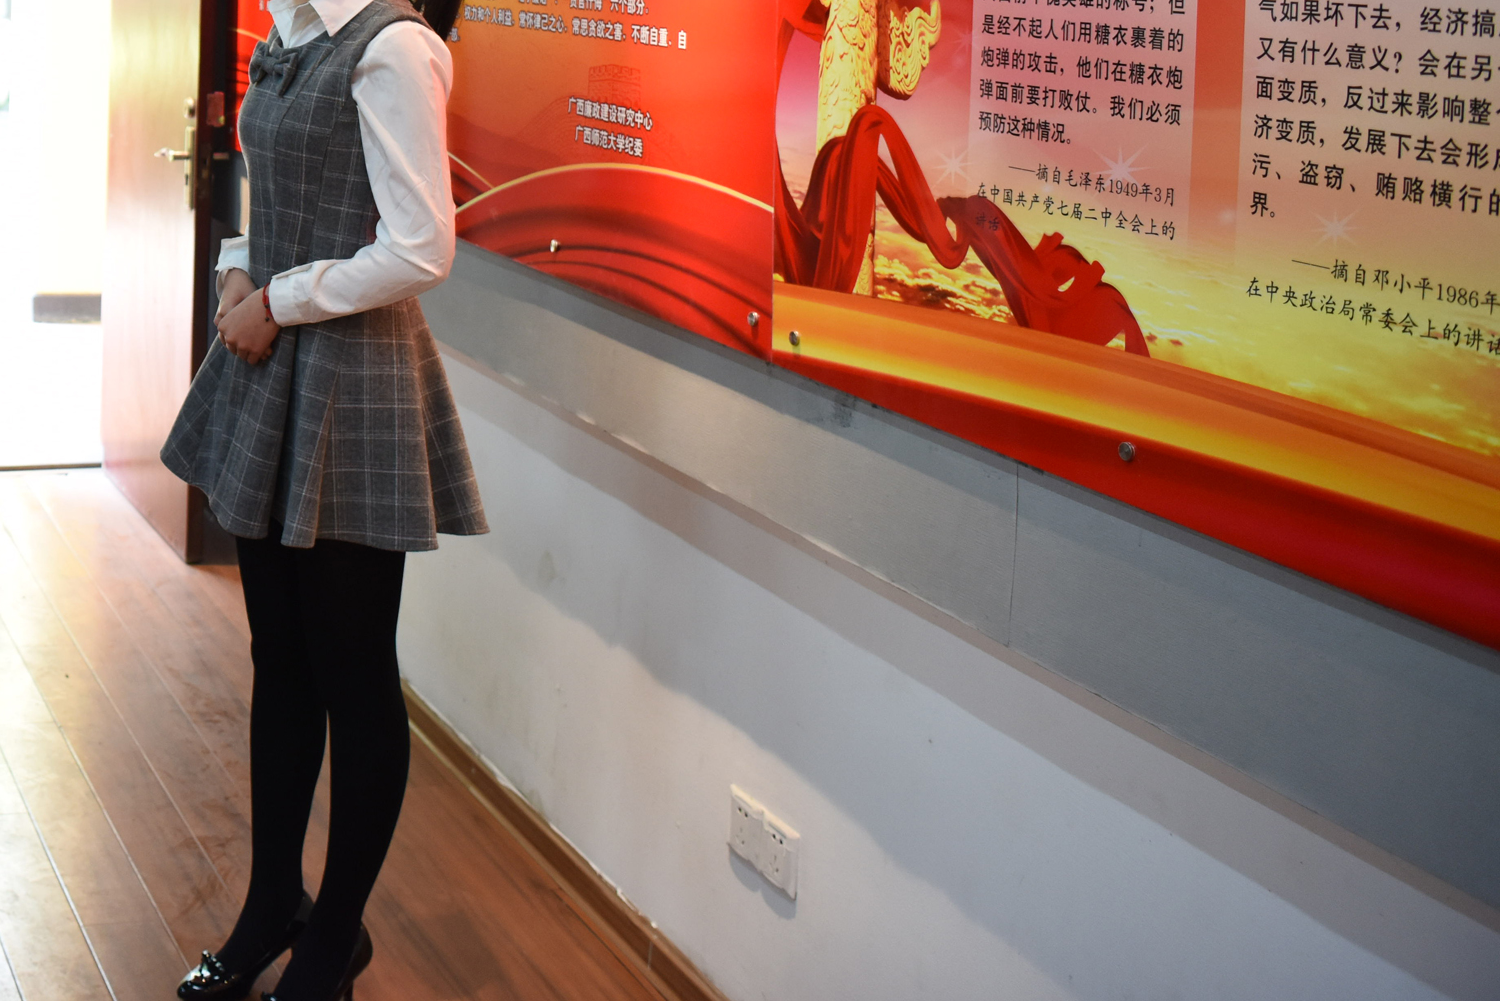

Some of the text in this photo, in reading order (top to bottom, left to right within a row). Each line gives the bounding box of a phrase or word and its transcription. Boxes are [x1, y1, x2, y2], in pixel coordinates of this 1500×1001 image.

[981, 14, 1184, 52] 是经不起人们用糖衣裹着的
[980, 47, 1183, 90] 炮弹的攻击，他们在糖衣炮
[1256, 36, 1500, 82] 又有什么意义？会在另
[567, 96, 654, 131] 广西廉政建设研究中心
[979, 79, 1182, 126] 弹面前要打败仗。我们必须
[1255, 75, 1500, 126] 面变质，反过来影响整
[575, 124, 644, 158] 广西师范大学纪委
[978, 111, 1072, 145] 预防这种情况。
[976, 182, 1176, 240] 在中国共产党七届二中全会上的
[1250, 190, 1276, 219] 界。
[1246, 276, 1500, 356] 在中央政治局常委会上的讲话
